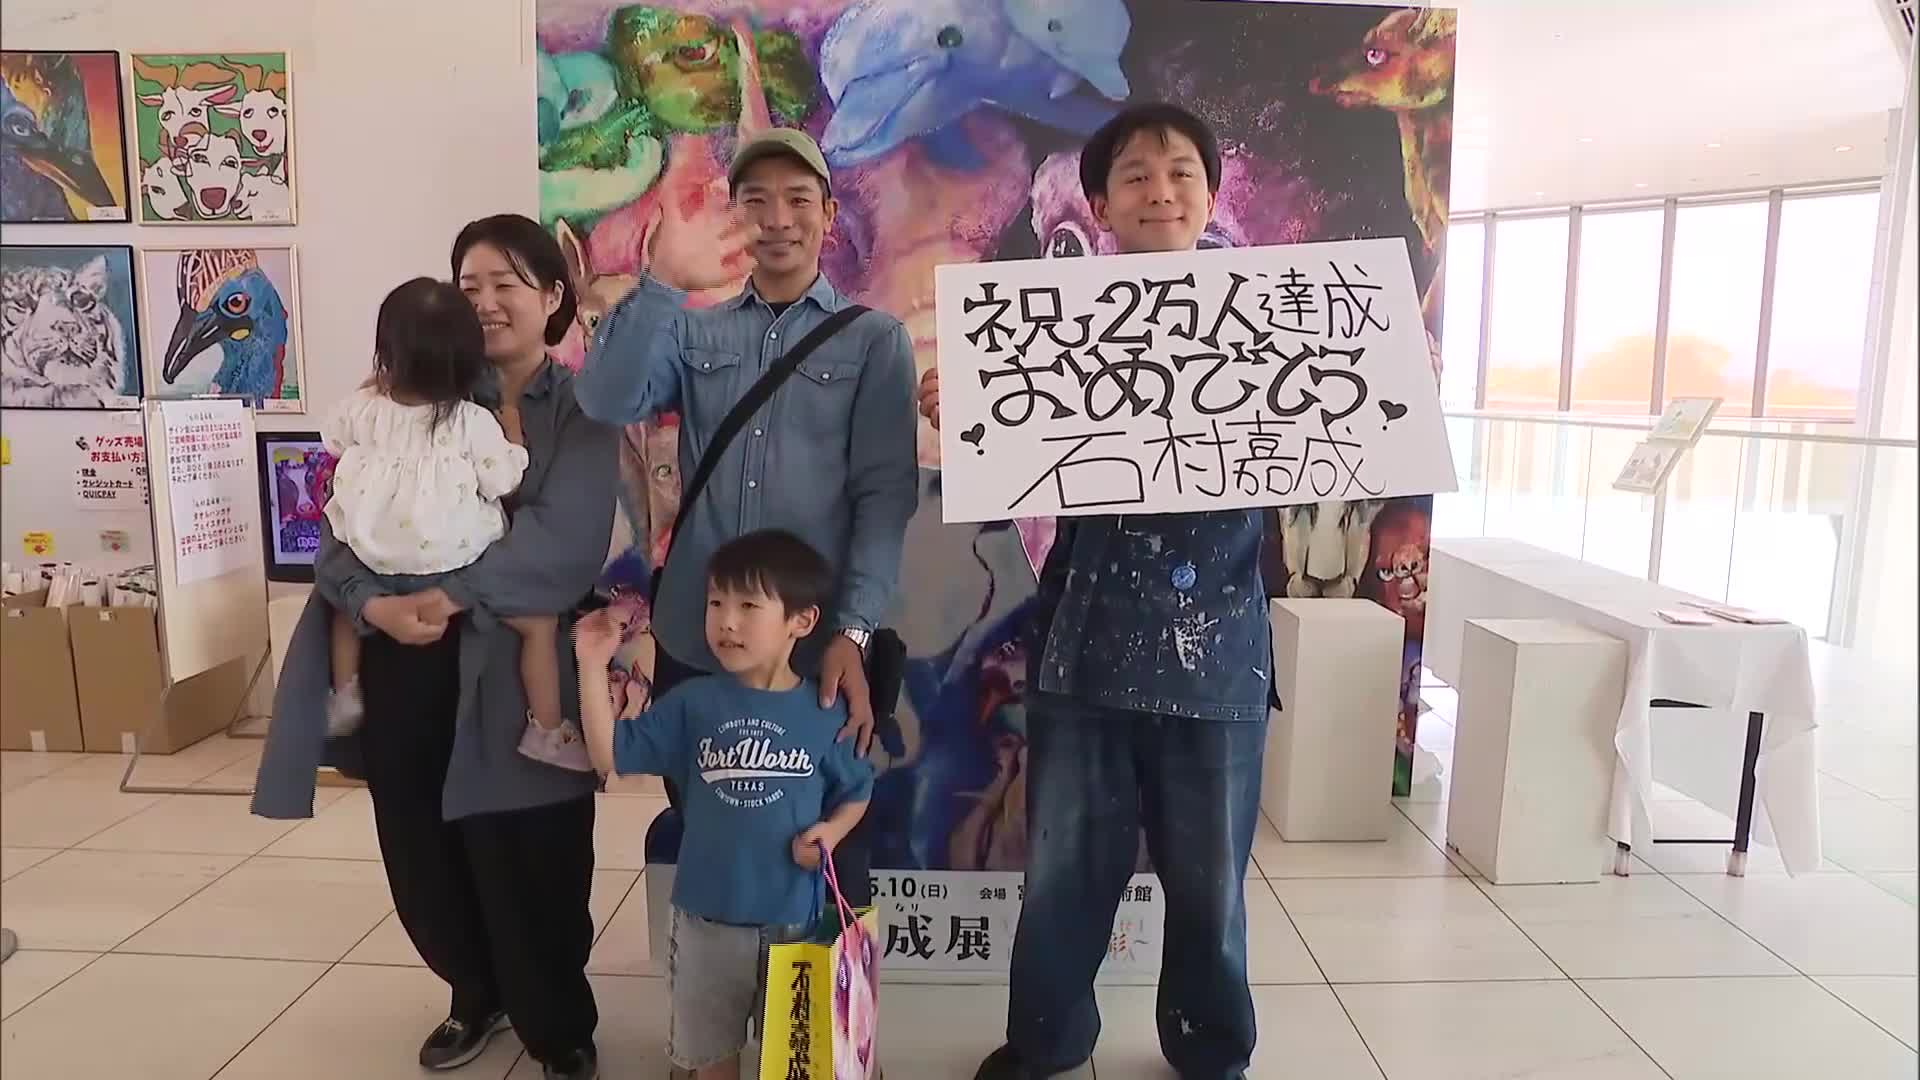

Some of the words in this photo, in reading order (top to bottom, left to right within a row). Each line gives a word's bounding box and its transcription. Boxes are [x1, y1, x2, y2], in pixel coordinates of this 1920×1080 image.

[979, 340, 1368, 426] おめでとう
[1007, 409, 1386, 510] 石村嘉成
[698, 736, 738, 769] Fort
[735, 736, 814, 771] Worth
[731, 780, 765, 792] TEXAS
[979, 887, 1007, 900] 会場
[883, 914, 992, 961] 成展
